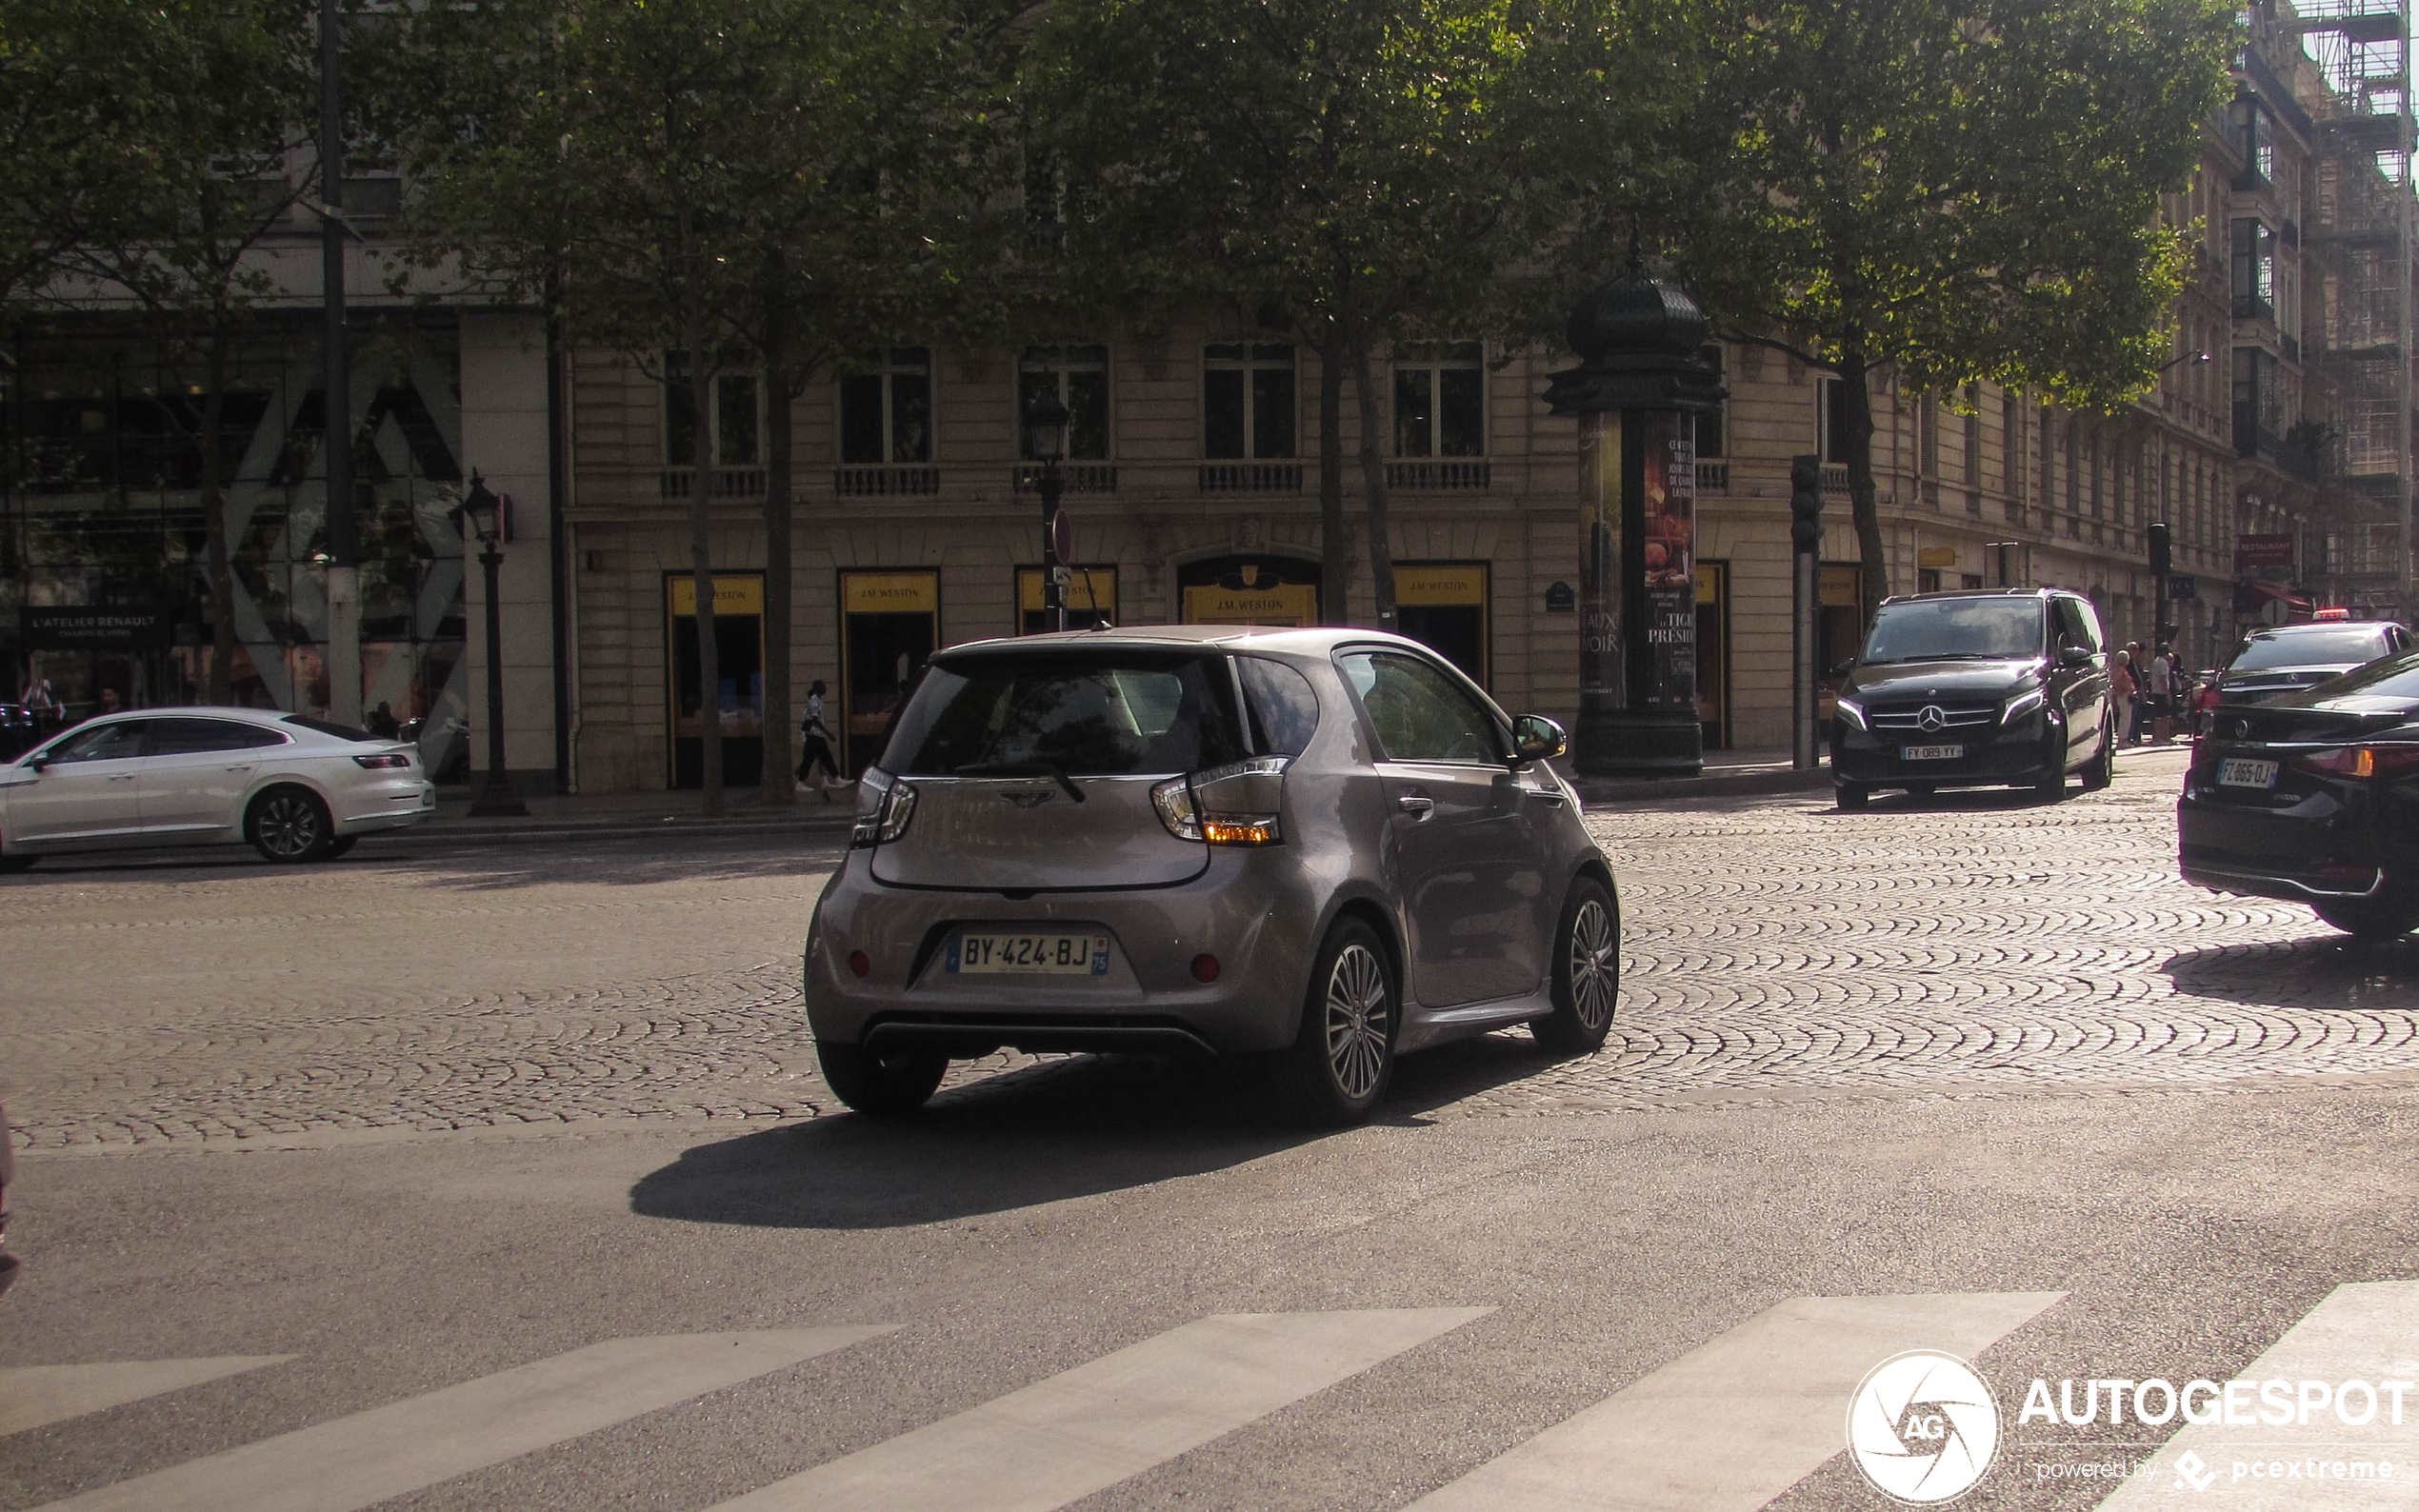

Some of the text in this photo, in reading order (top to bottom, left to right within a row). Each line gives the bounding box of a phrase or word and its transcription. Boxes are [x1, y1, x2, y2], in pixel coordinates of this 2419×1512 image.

[1429, 582, 1468, 590] WESTON
[879, 589, 919, 598] WESTON
[1240, 600, 1284, 609] WESTON
[32, 616, 156, 627] L'ATELIER RENAULT
[965, 938, 1089, 965] BY-424-BJ
